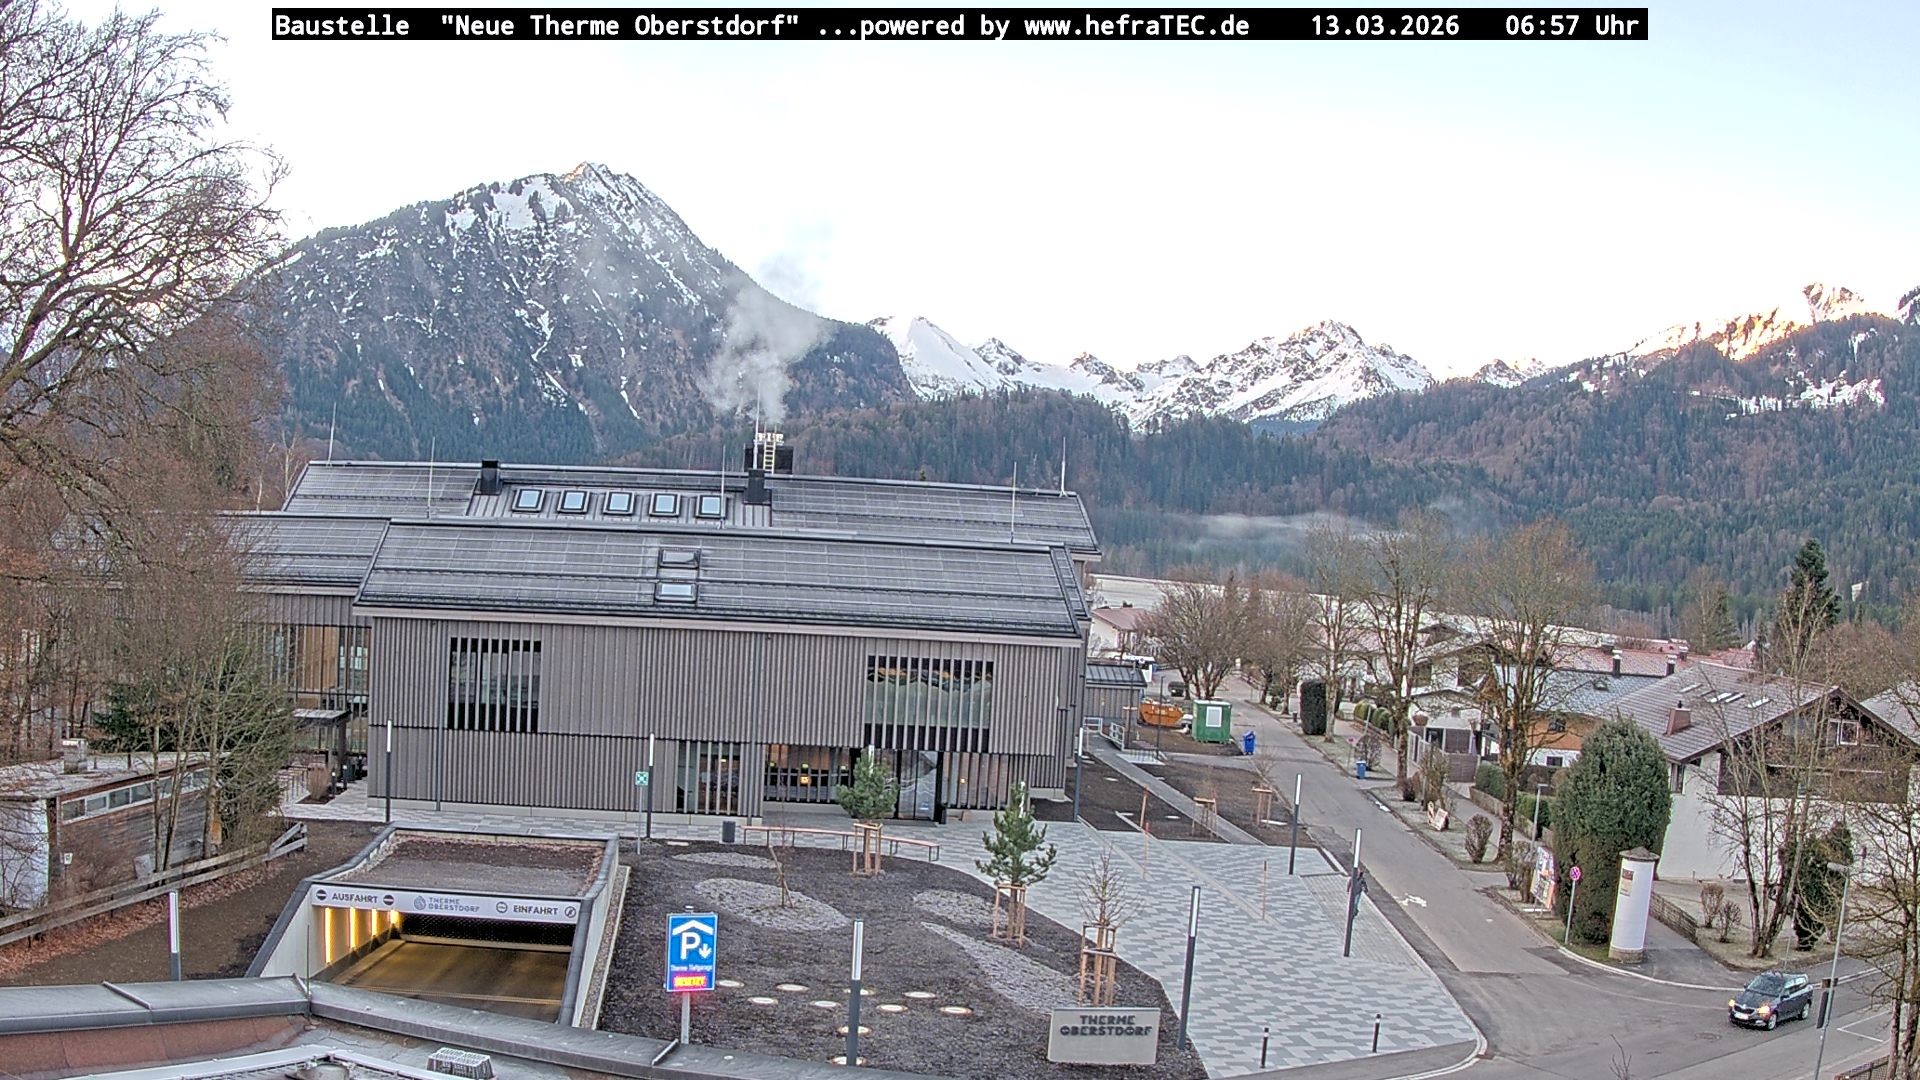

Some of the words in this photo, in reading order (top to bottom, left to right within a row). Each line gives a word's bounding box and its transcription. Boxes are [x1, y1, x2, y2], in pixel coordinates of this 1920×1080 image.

[331, 892, 378, 904] AUSFAHRT
[513, 904, 559, 916] EINFAHRT
[680, 931, 701, 961] P
[1079, 1014, 1136, 1026] THERME
[1060, 1025, 1153, 1037] OBERSTDORF
